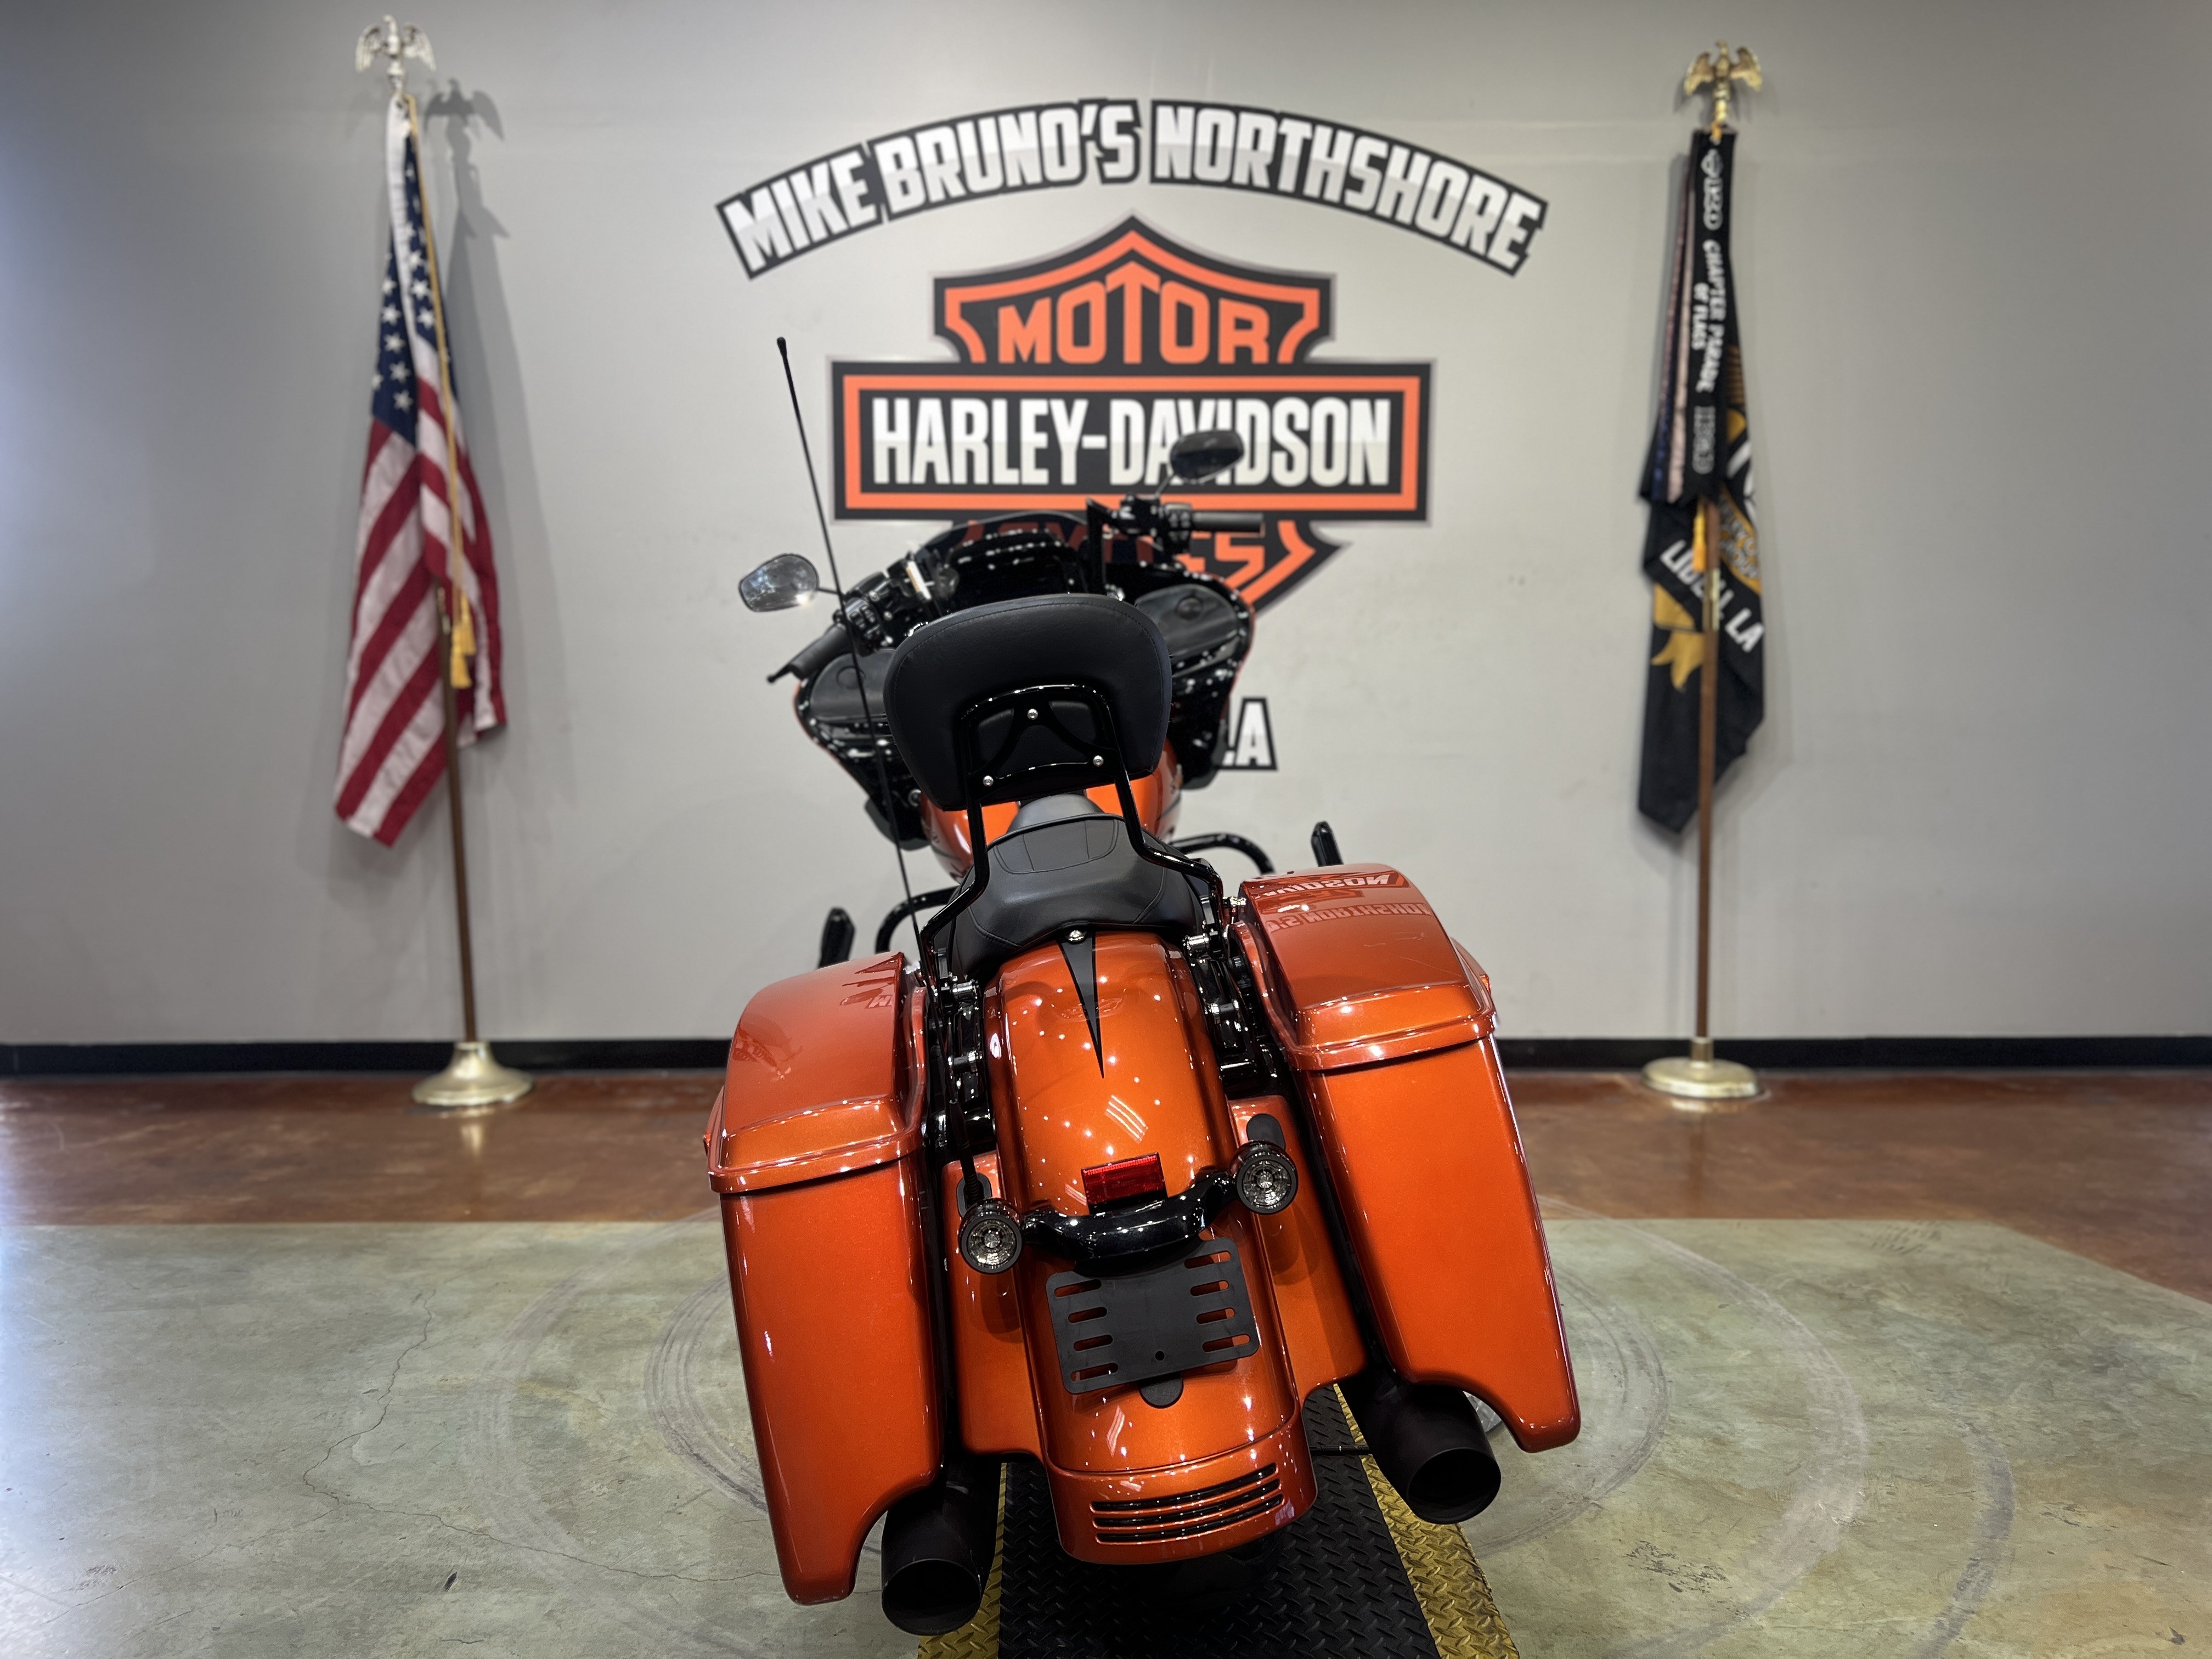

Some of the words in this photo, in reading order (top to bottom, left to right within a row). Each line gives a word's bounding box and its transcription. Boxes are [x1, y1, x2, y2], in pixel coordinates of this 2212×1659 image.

[720, 147, 879, 276] MIKE
[872, 101, 1139, 216] BRUNO'S
[1152, 102, 1544, 273] NORTHSHORE
[998, 260, 1269, 364] MOTOR
[1725, 607, 1764, 652] LA
